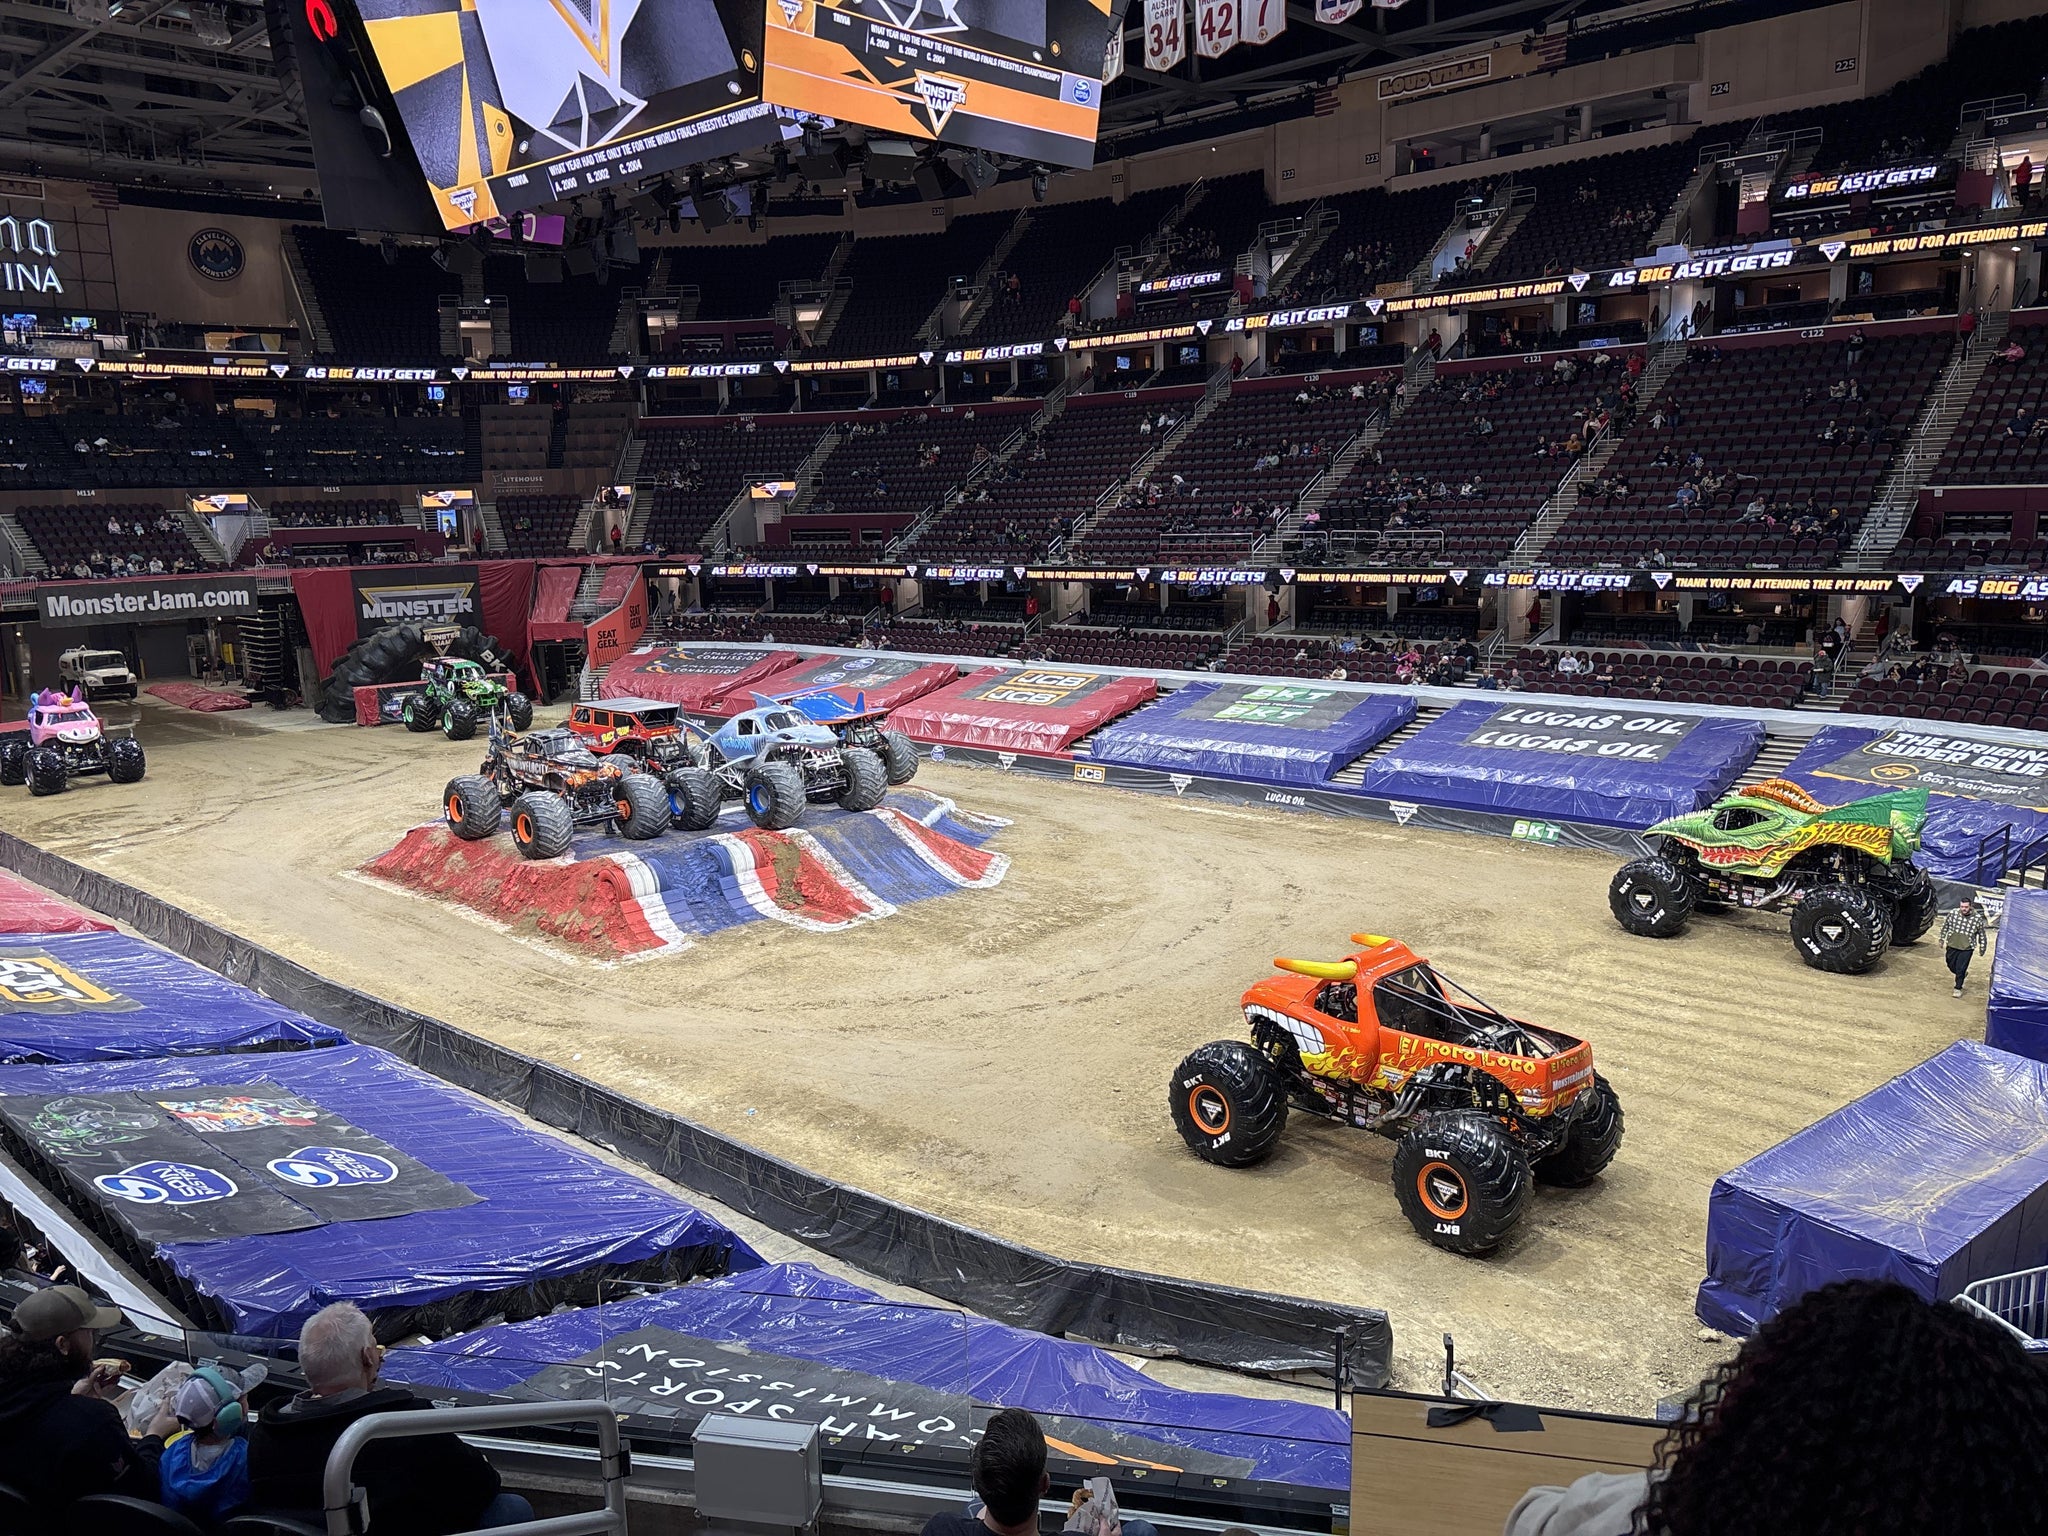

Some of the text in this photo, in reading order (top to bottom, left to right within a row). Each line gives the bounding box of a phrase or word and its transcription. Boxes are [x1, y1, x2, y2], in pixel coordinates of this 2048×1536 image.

[1154, 9, 1174, 20] CARR
[1201, 3, 1232, 42] 42
[1150, 18, 1179, 57] 34
[1836, 60, 1854, 71] 225
[1380, 56, 1488, 97] LOUDVILLE
[914, 81, 966, 104] MONSTER
[1712, 83, 1728, 94] 224
[926, 96, 953, 111] JAM
[1367, 154, 1378, 162] 223
[1785, 167, 1937, 198] AS BIG AS IT GETS!
[196, 232, 235, 247] CLEVELAND
[1850, 223, 2048, 256] THANK YOU FOR ATTENDING THE
[200, 264, 236, 278] MONSTERS
[1608, 252, 1794, 286] AS BIG AS IT GETS!
[0, 263, 64, 294] INA
[1386, 282, 1565, 312] THANK YOU FOR ATTENDING THE PIT PARTY
[1225, 306, 1350, 331] AS BIG AS IT GETS!
[7, 359, 57, 371] GETS!
[648, 364, 761, 377] AS BIG AS IT GETS!
[305, 368, 436, 380] AS BIG AS IT GETS!
[1483, 574, 1631, 587] AS BIG AS IT GETS!
[1675, 578, 1893, 590] THANK YOU FOR ATTENDING THE PIT PARTY
[1946, 579, 2048, 596] AS BIG AS
[46, 590, 249, 617] MonsterJam.com
[362, 598, 473, 619] MONSTER
[630, 604, 640, 617] SEAT
[630, 616, 642, 629] GEEK
[424, 631, 460, 642] MONSTER
[598, 629, 616, 639] SEAT
[598, 639, 618, 648] GEEK
[1017, 674, 1087, 686] JCB
[988, 690, 1058, 702] JCB
[1248, 688, 1332, 700] BKT
[1498, 709, 1622, 730] LUCAS
[1471, 732, 1598, 752] LUCAS
[1892, 733, 1949, 748] THE
[1873, 742, 2048, 776] SUPER GLUE
[1076, 768, 1102, 779] JCB
[1917, 774, 1944, 785] TOOL
[1956, 782, 2024, 795] EQUIPMENT
[1265, 792, 1292, 803] LUCAS
[1514, 822, 1561, 839] BKT
[1798, 822, 1892, 849] DRAGON
[1619, 877, 1633, 894] BKT
[1651, 908, 1665, 924] BKT
[1841, 910, 1861, 929] BKT
[1802, 936, 1821, 955] BKT
[1184, 1074, 1204, 1089] BKT
[1212, 1132, 1231, 1149] BKT
[1425, 1148, 1450, 1160] BKT
[316, 1153, 370, 1178] SPIN
[152, 1167, 204, 1197] SPIN
[1434, 1222, 1460, 1235] BKT
[585, 1360, 796, 1420] SPORTS
